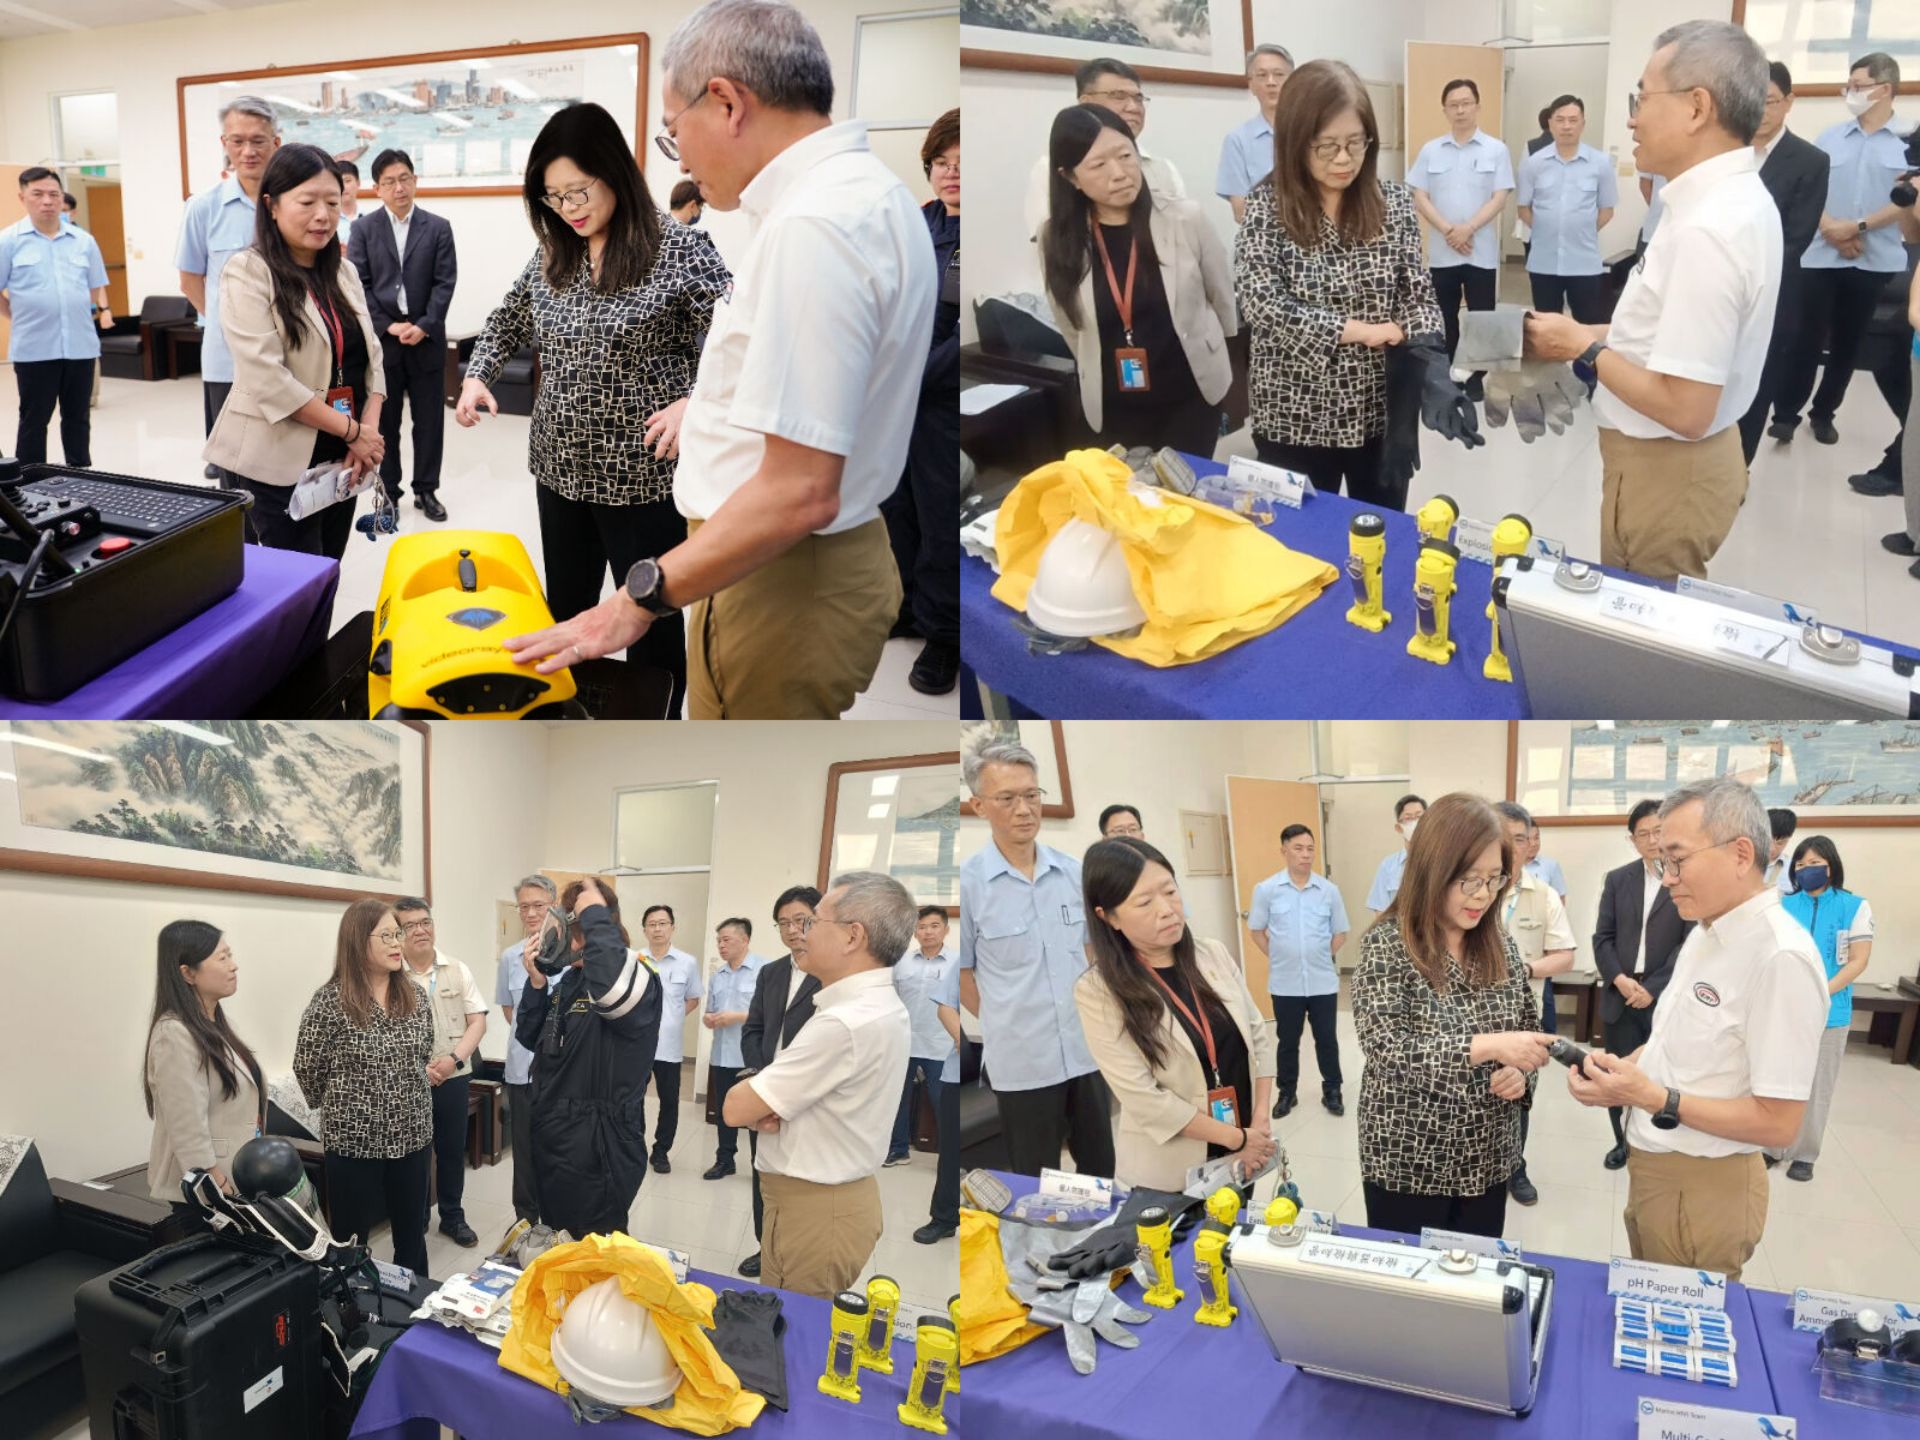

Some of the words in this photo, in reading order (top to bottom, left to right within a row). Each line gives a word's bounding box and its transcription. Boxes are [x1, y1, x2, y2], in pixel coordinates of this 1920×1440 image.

[1627, 1277, 1644, 1289] pH
[1647, 1279, 1679, 1294] Paper
[1682, 1286, 1704, 1298] Roll
[1821, 1306, 1838, 1317] Gas
[1799, 1313, 1834, 1325] Ammo
